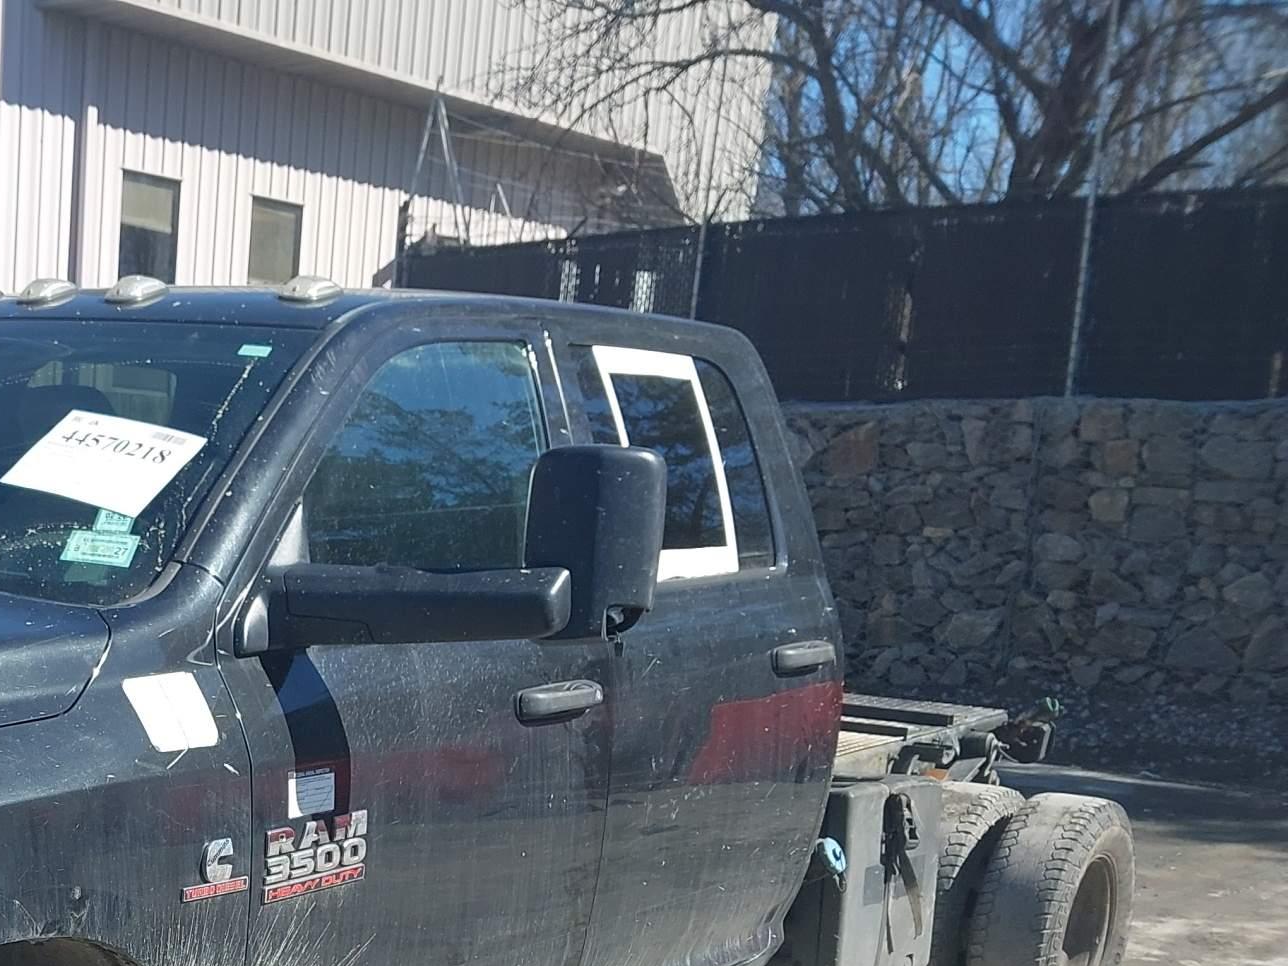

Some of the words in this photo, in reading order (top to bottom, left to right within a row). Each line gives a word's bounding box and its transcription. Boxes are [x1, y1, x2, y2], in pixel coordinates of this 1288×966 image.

[61, 429, 173, 465] 44570218
[265, 809, 368, 857] RAM
[263, 837, 367, 885] 3500
[268, 878, 321, 900] HEAVY
[320, 867, 363, 887] DUTY
